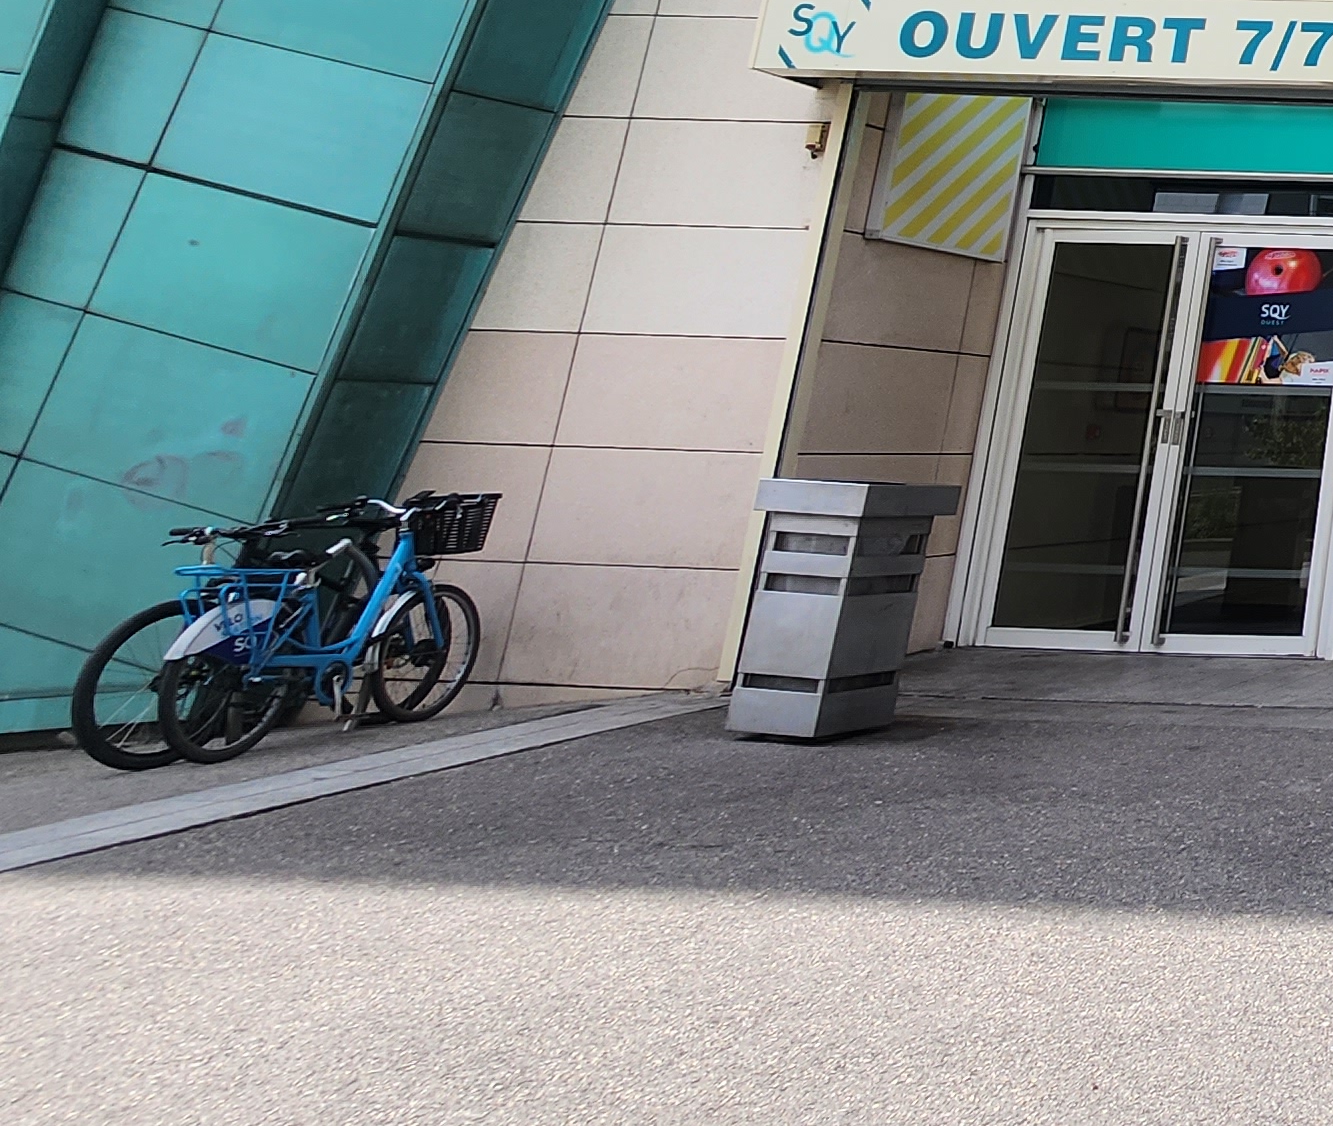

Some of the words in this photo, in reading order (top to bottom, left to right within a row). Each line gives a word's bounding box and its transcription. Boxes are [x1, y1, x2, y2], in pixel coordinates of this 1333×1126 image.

[787, 3, 856, 58] SQY
[899, 12, 1206, 65] OUVERT
[1261, 304, 1291, 320] SQY
